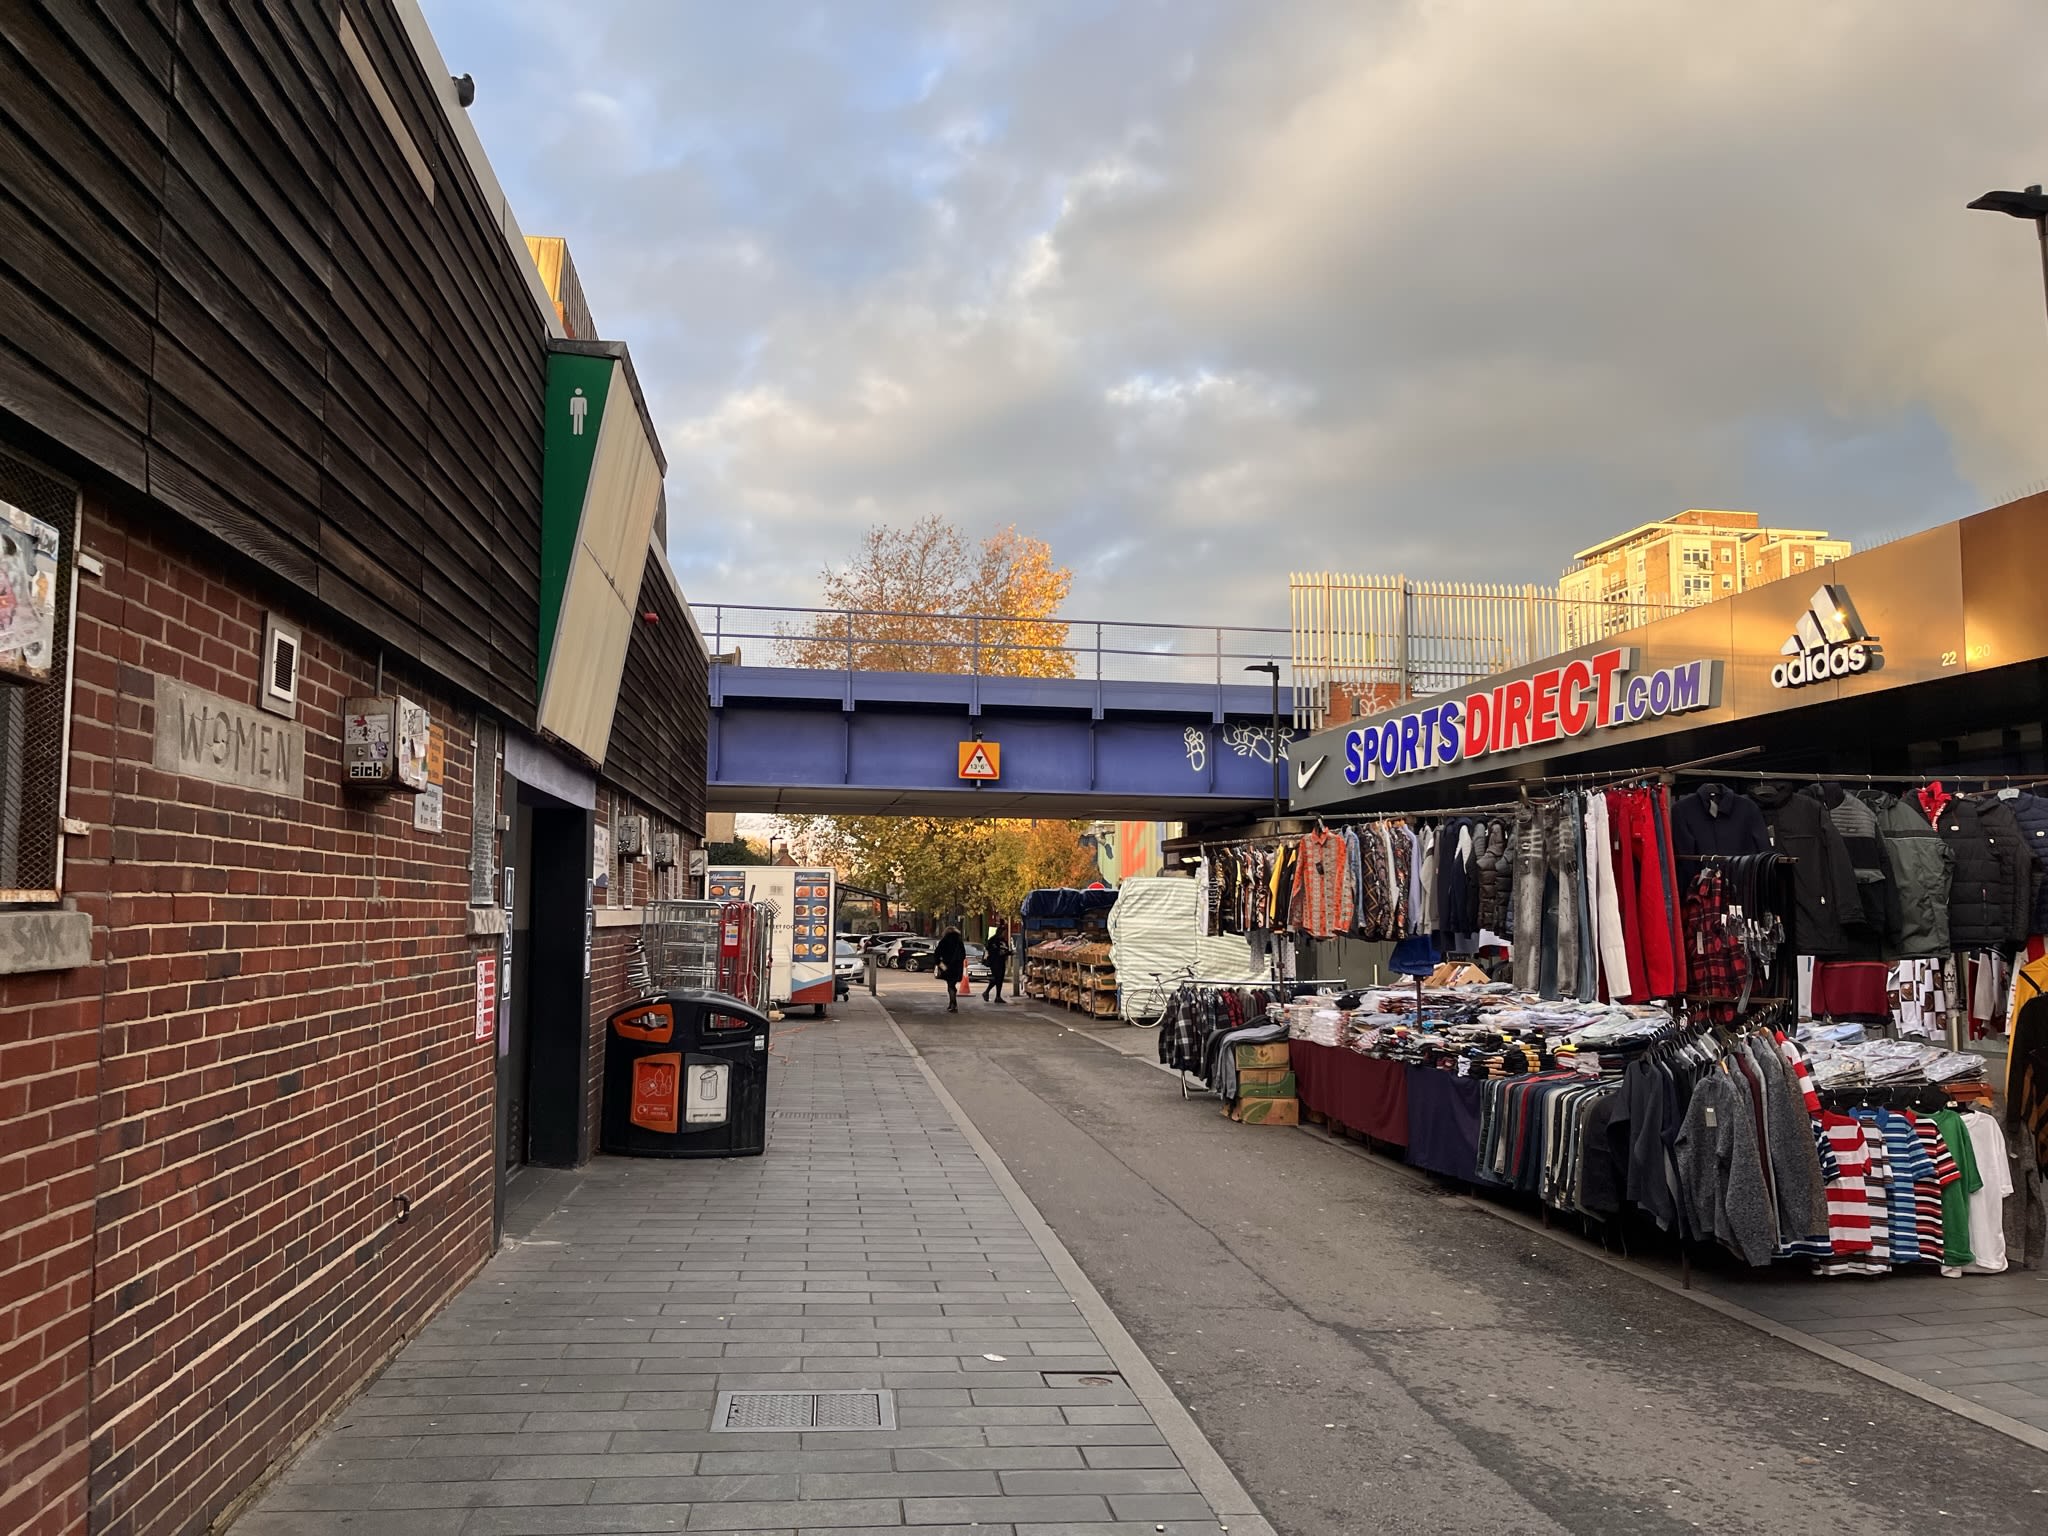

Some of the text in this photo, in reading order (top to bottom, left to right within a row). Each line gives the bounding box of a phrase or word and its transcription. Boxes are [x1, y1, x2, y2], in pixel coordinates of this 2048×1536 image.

[1771, 643, 1867, 689] adidas
[1941, 650, 1957, 667] 22
[1975, 643, 1991, 658] 20
[1344, 647, 1709, 786] SPORTSDIRECT.COM
[178, 698, 292, 783] WOMEN
[351, 762, 382, 777] sick
